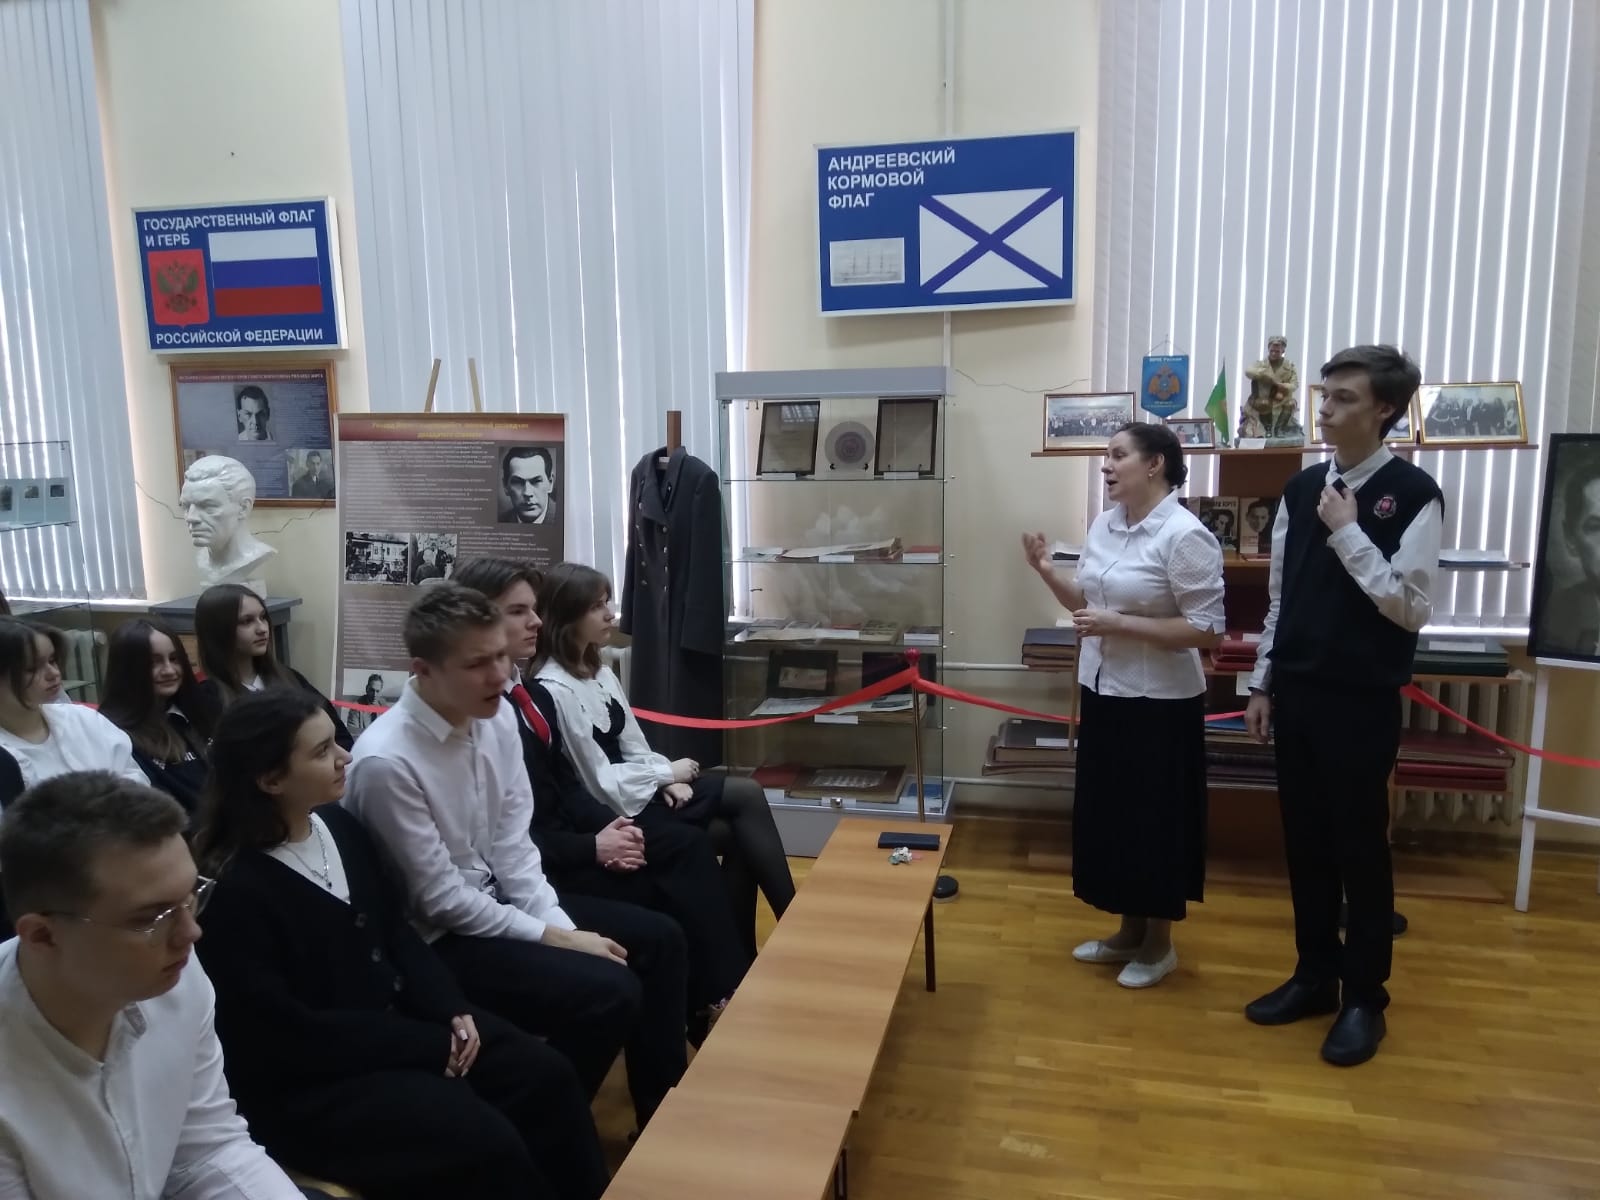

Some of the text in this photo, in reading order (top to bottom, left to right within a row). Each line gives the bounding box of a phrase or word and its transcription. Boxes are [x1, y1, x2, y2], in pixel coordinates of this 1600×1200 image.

[828, 147, 955, 172] АНДРЕЕВСКИЙ
[827, 168, 924, 190] КОРМОВОЙ
[828, 192, 875, 209] ФЛАГ
[143, 208, 316, 231] ГОСУДАРСТВЕННЫЙ ФЛАГ
[145, 233, 190, 248] И ГЕРБ
[156, 328, 323, 345] РОССИЙСКОЙ ФЕДЕРАЦИИ
